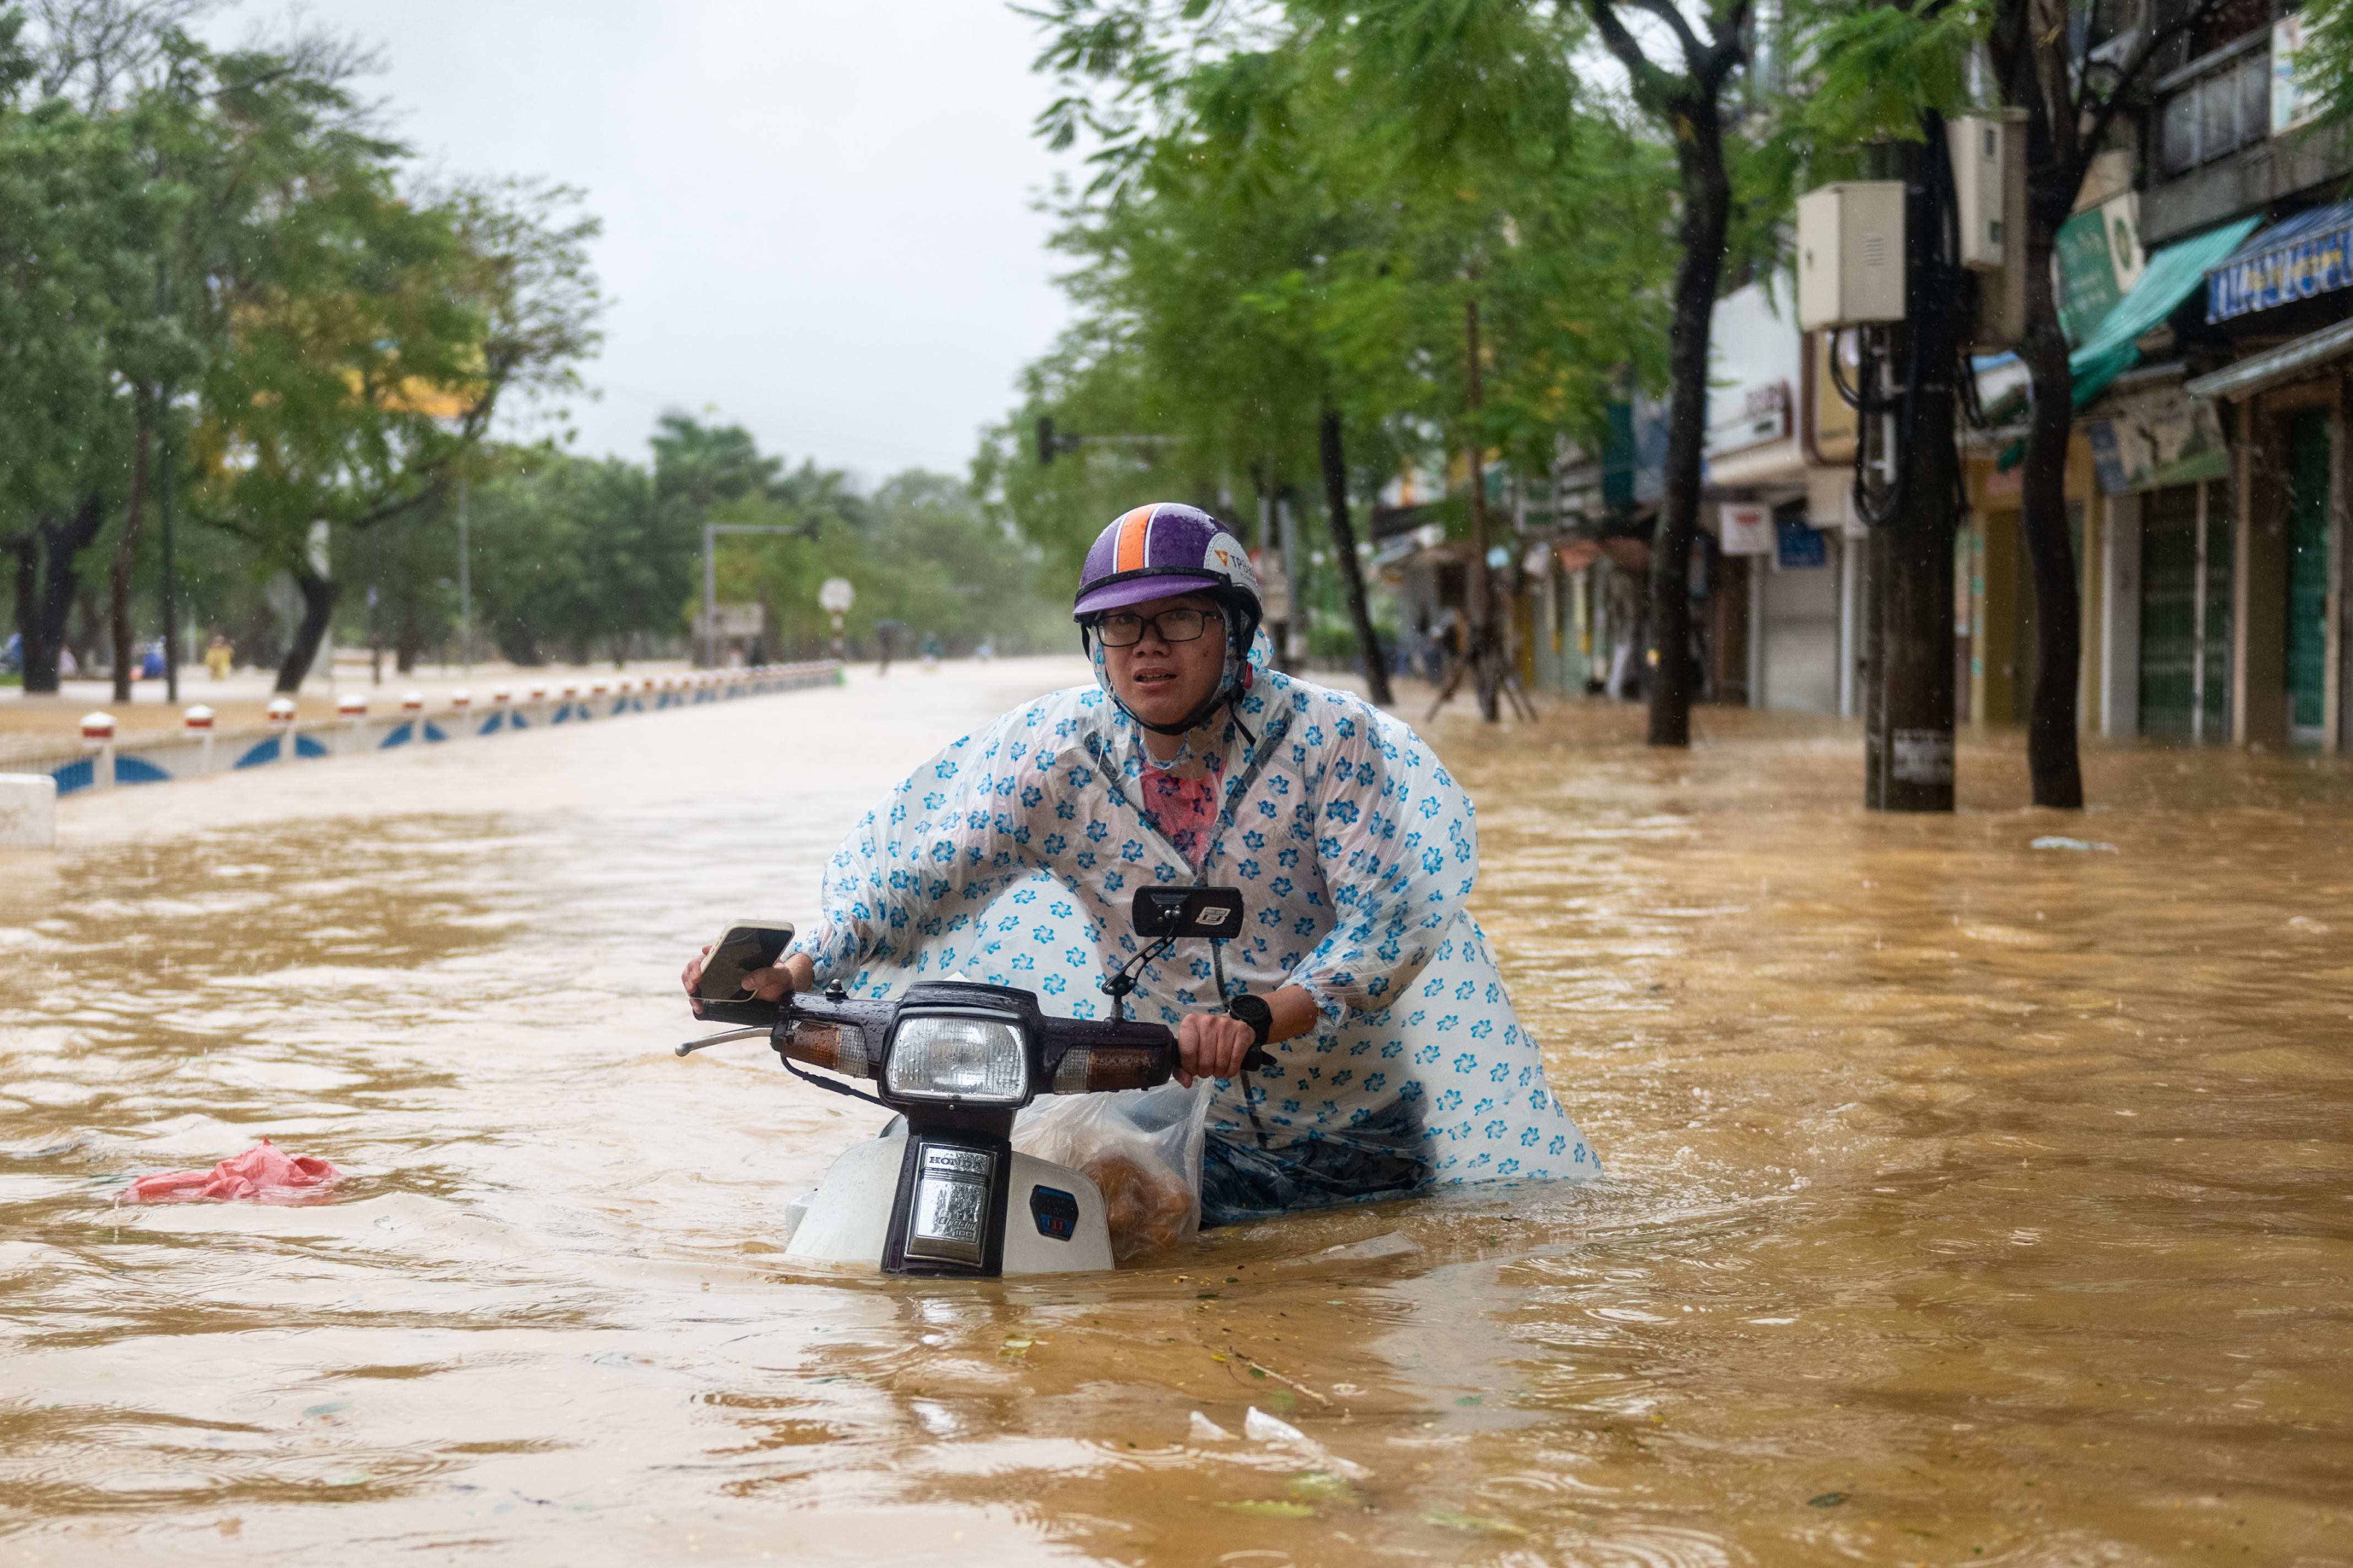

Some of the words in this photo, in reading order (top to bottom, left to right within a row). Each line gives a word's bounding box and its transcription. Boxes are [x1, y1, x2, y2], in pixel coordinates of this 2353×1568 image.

[929, 1157, 985, 1170] HONDA
[938, 1216, 977, 1229] Dream
[955, 1228, 975, 1239] 100
